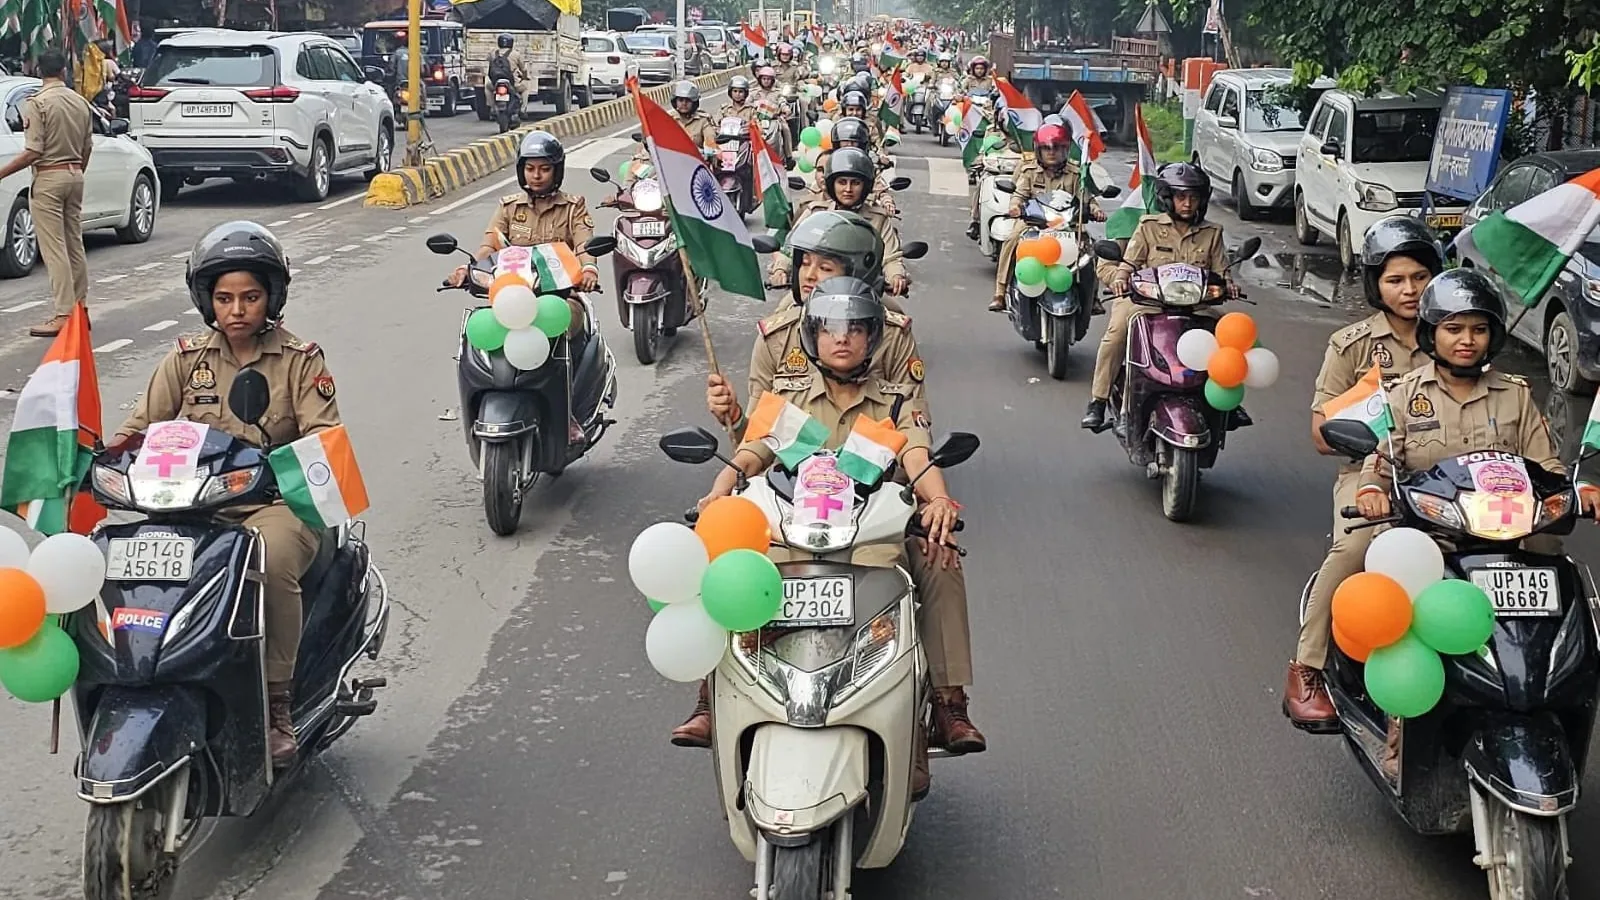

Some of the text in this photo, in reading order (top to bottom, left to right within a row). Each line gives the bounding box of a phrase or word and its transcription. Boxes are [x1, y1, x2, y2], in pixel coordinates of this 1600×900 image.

[1457, 452, 1524, 465] POLICE
[138, 531, 180, 539] HONDA
[125, 541, 184, 558] UP14G
[122, 560, 182, 577] A5618
[1493, 571, 1549, 589] UP14G
[783, 581, 844, 599] UP14G
[1494, 590, 1549, 608] U6687
[783, 600, 844, 618] C7304
[116, 613, 164, 629] POLICE
